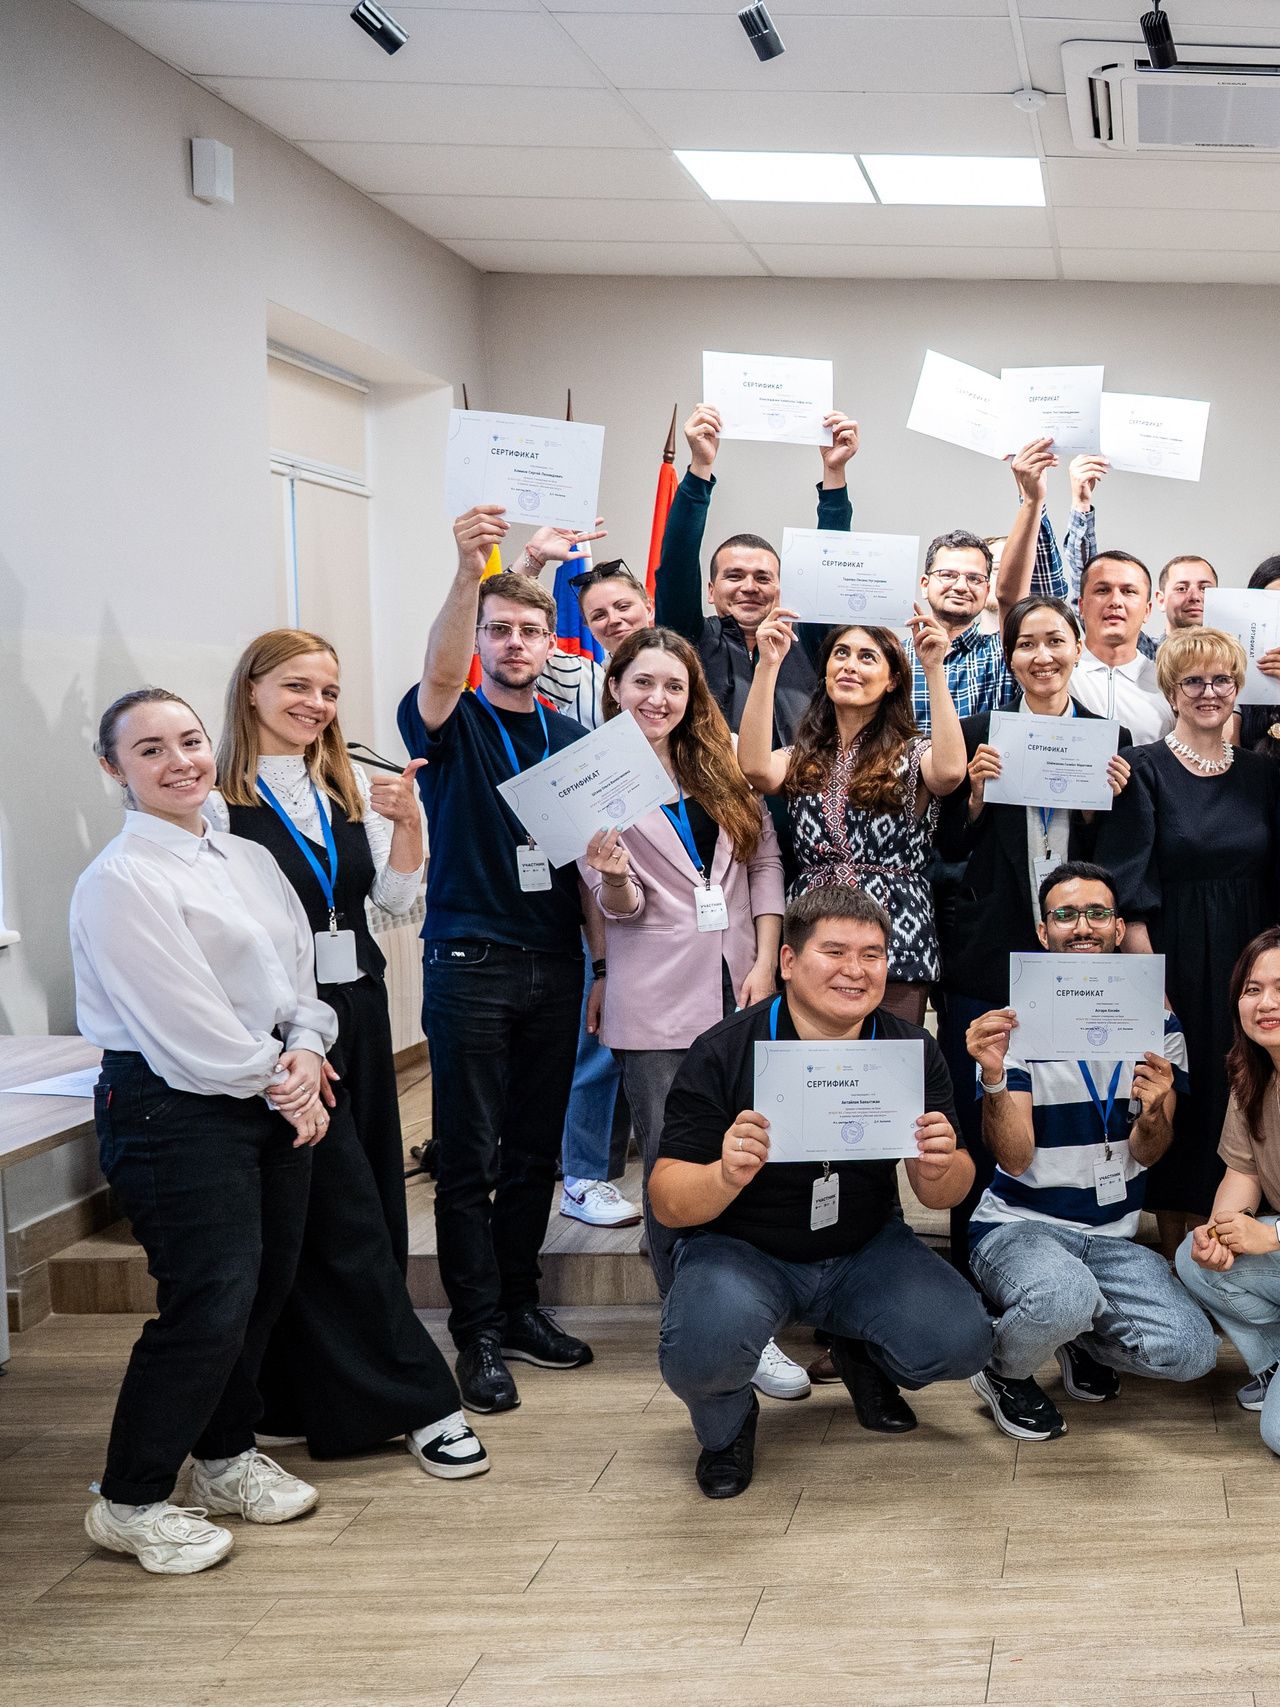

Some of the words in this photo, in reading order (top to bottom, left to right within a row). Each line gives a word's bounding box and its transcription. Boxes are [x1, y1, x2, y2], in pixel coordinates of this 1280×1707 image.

[743, 382, 783, 390] СЕРТИФИКАТ
[491, 448, 539, 459] СЕРТИФИКАТ
[822, 560, 864, 568] СЕРТИФИКАТ
[1028, 744, 1068, 753] СЕРТИФИКАТ
[558, 770, 600, 798] СЕРТИФИКАТ
[806, 1080, 860, 1088] СЕРТИФИКАТ
[1099, 1172, 1120, 1180] УЧАСТНИК
